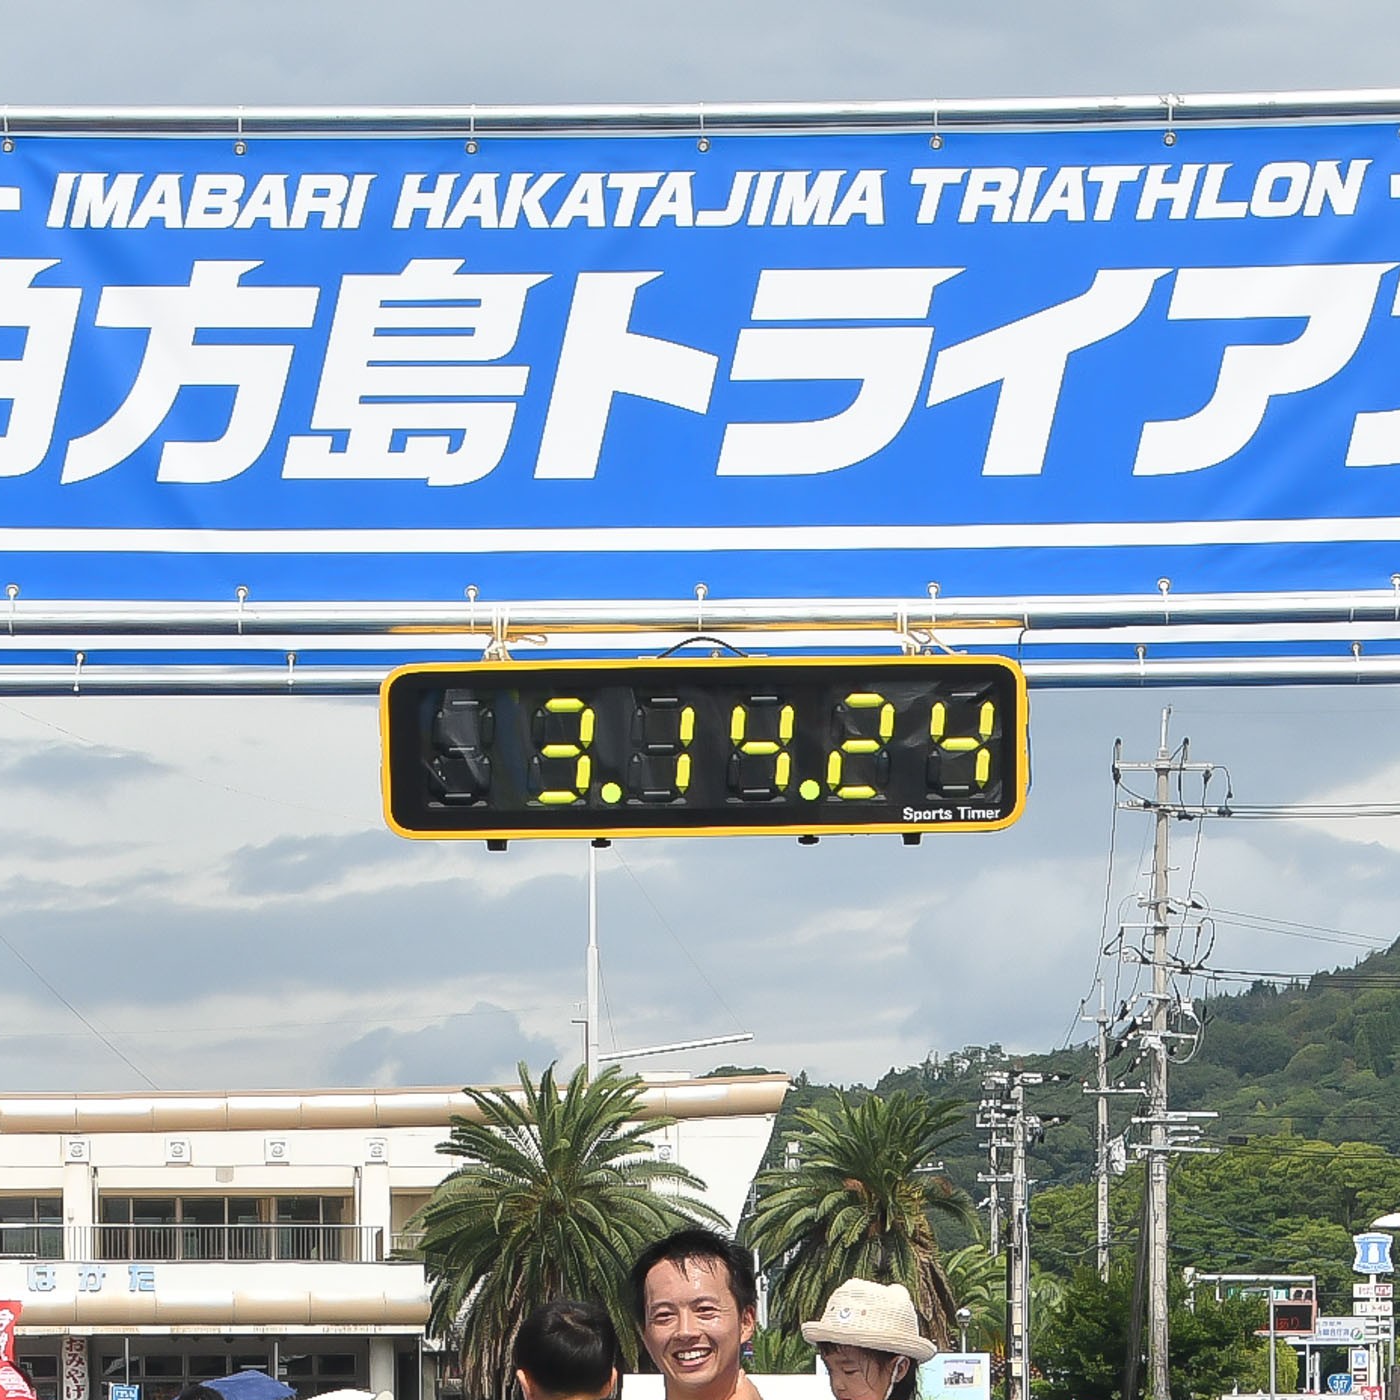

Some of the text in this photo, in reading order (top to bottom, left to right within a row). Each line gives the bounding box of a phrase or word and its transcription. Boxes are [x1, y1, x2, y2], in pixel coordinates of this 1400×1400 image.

[46, 159, 1374, 229] IMABARI HAKATAJIMA TRIATHLON
[536, 692, 996, 804] 3.14.24
[903, 806, 1001, 823] Sports Timer
